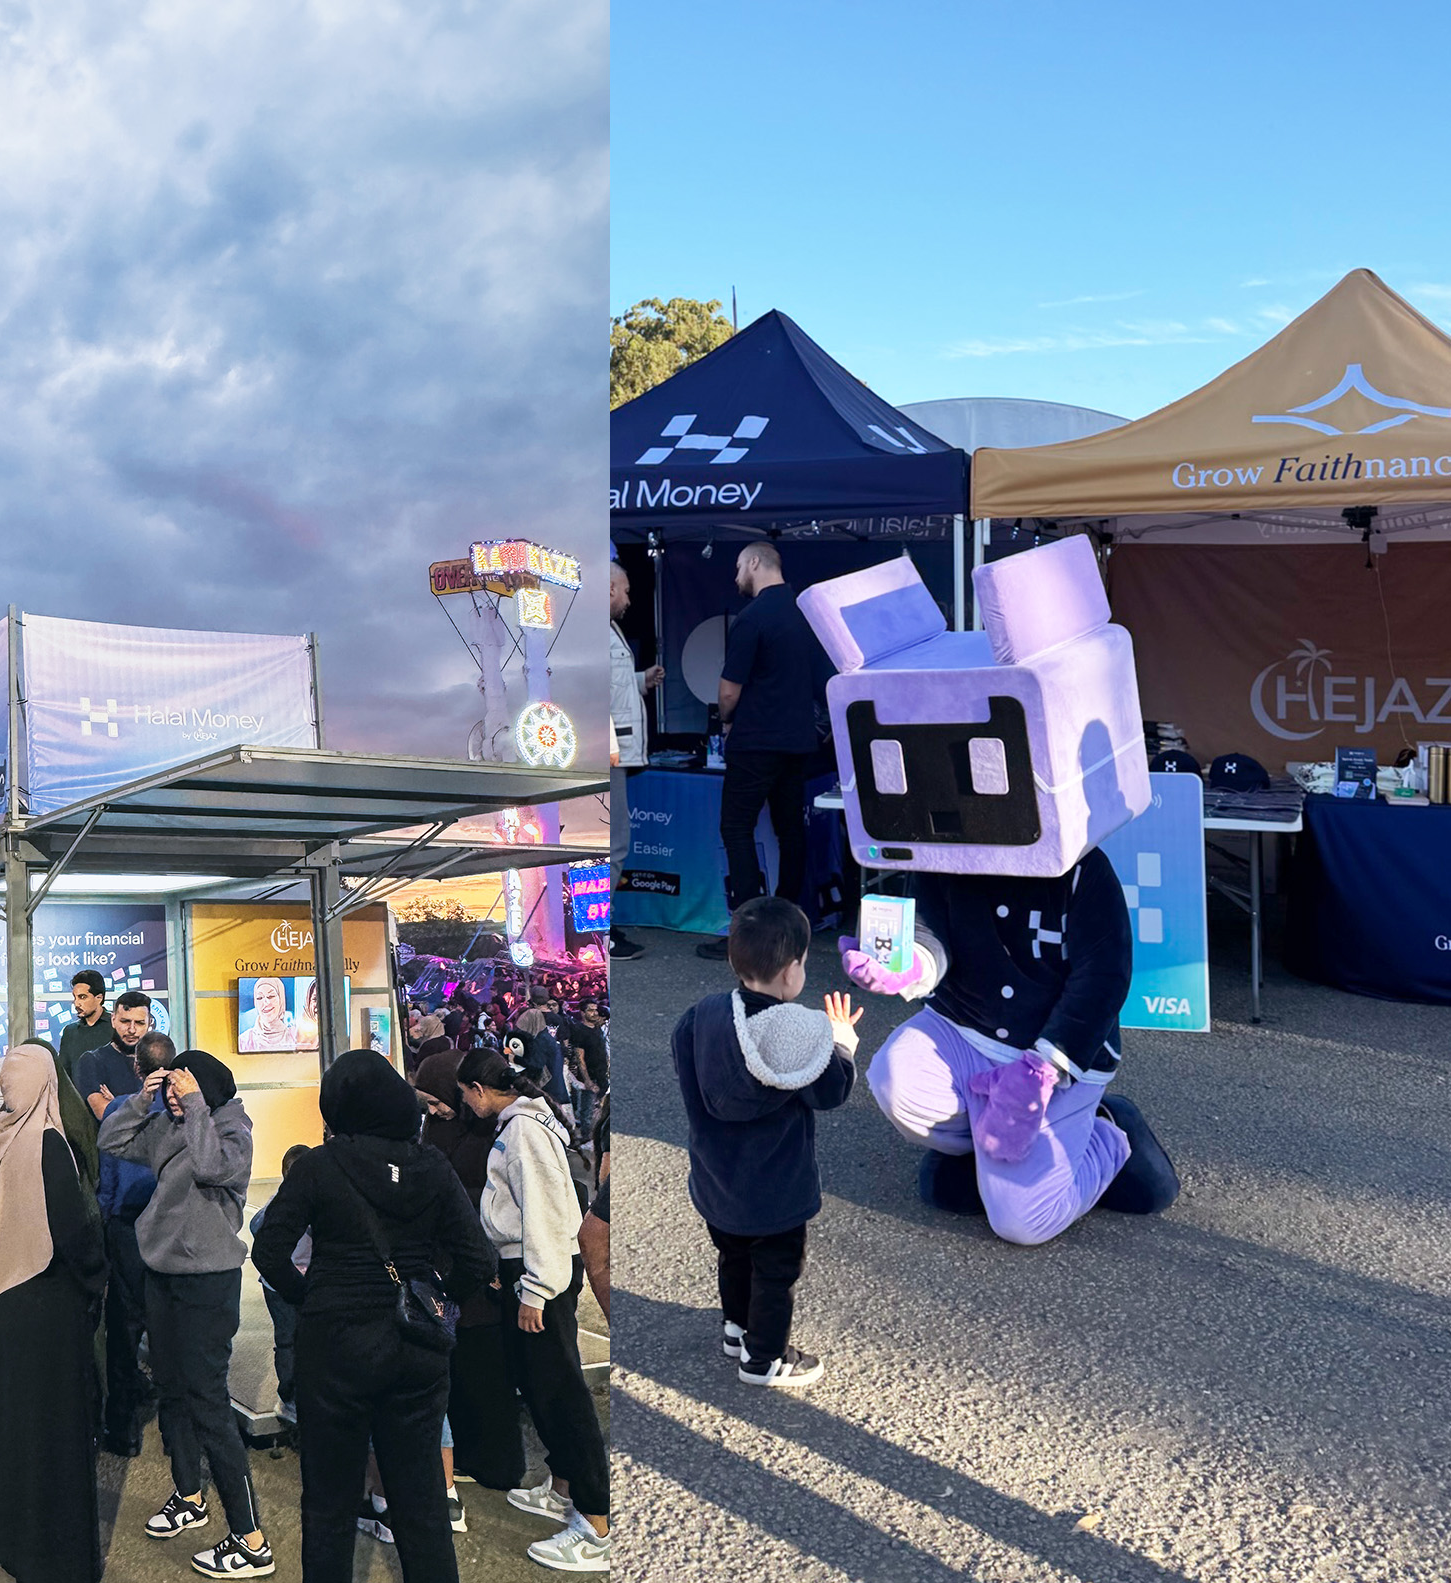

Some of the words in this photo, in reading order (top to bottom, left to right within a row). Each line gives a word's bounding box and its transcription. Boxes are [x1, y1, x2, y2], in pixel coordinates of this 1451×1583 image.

[1172, 463, 1264, 489] Grow
[636, 479, 763, 510] Money
[134, 704, 187, 726] Halal
[192, 708, 264, 734] Money
[633, 841, 675, 857] Easier
[631, 878, 661, 891] Google
[661, 880, 676, 894] Play
[49, 934, 82, 949] your
[85, 931, 144, 946] financial
[48, 951, 79, 966] look
[83, 952, 117, 966] like?
[235, 958, 270, 972] Grow
[1142, 996, 1191, 1016] VISA
